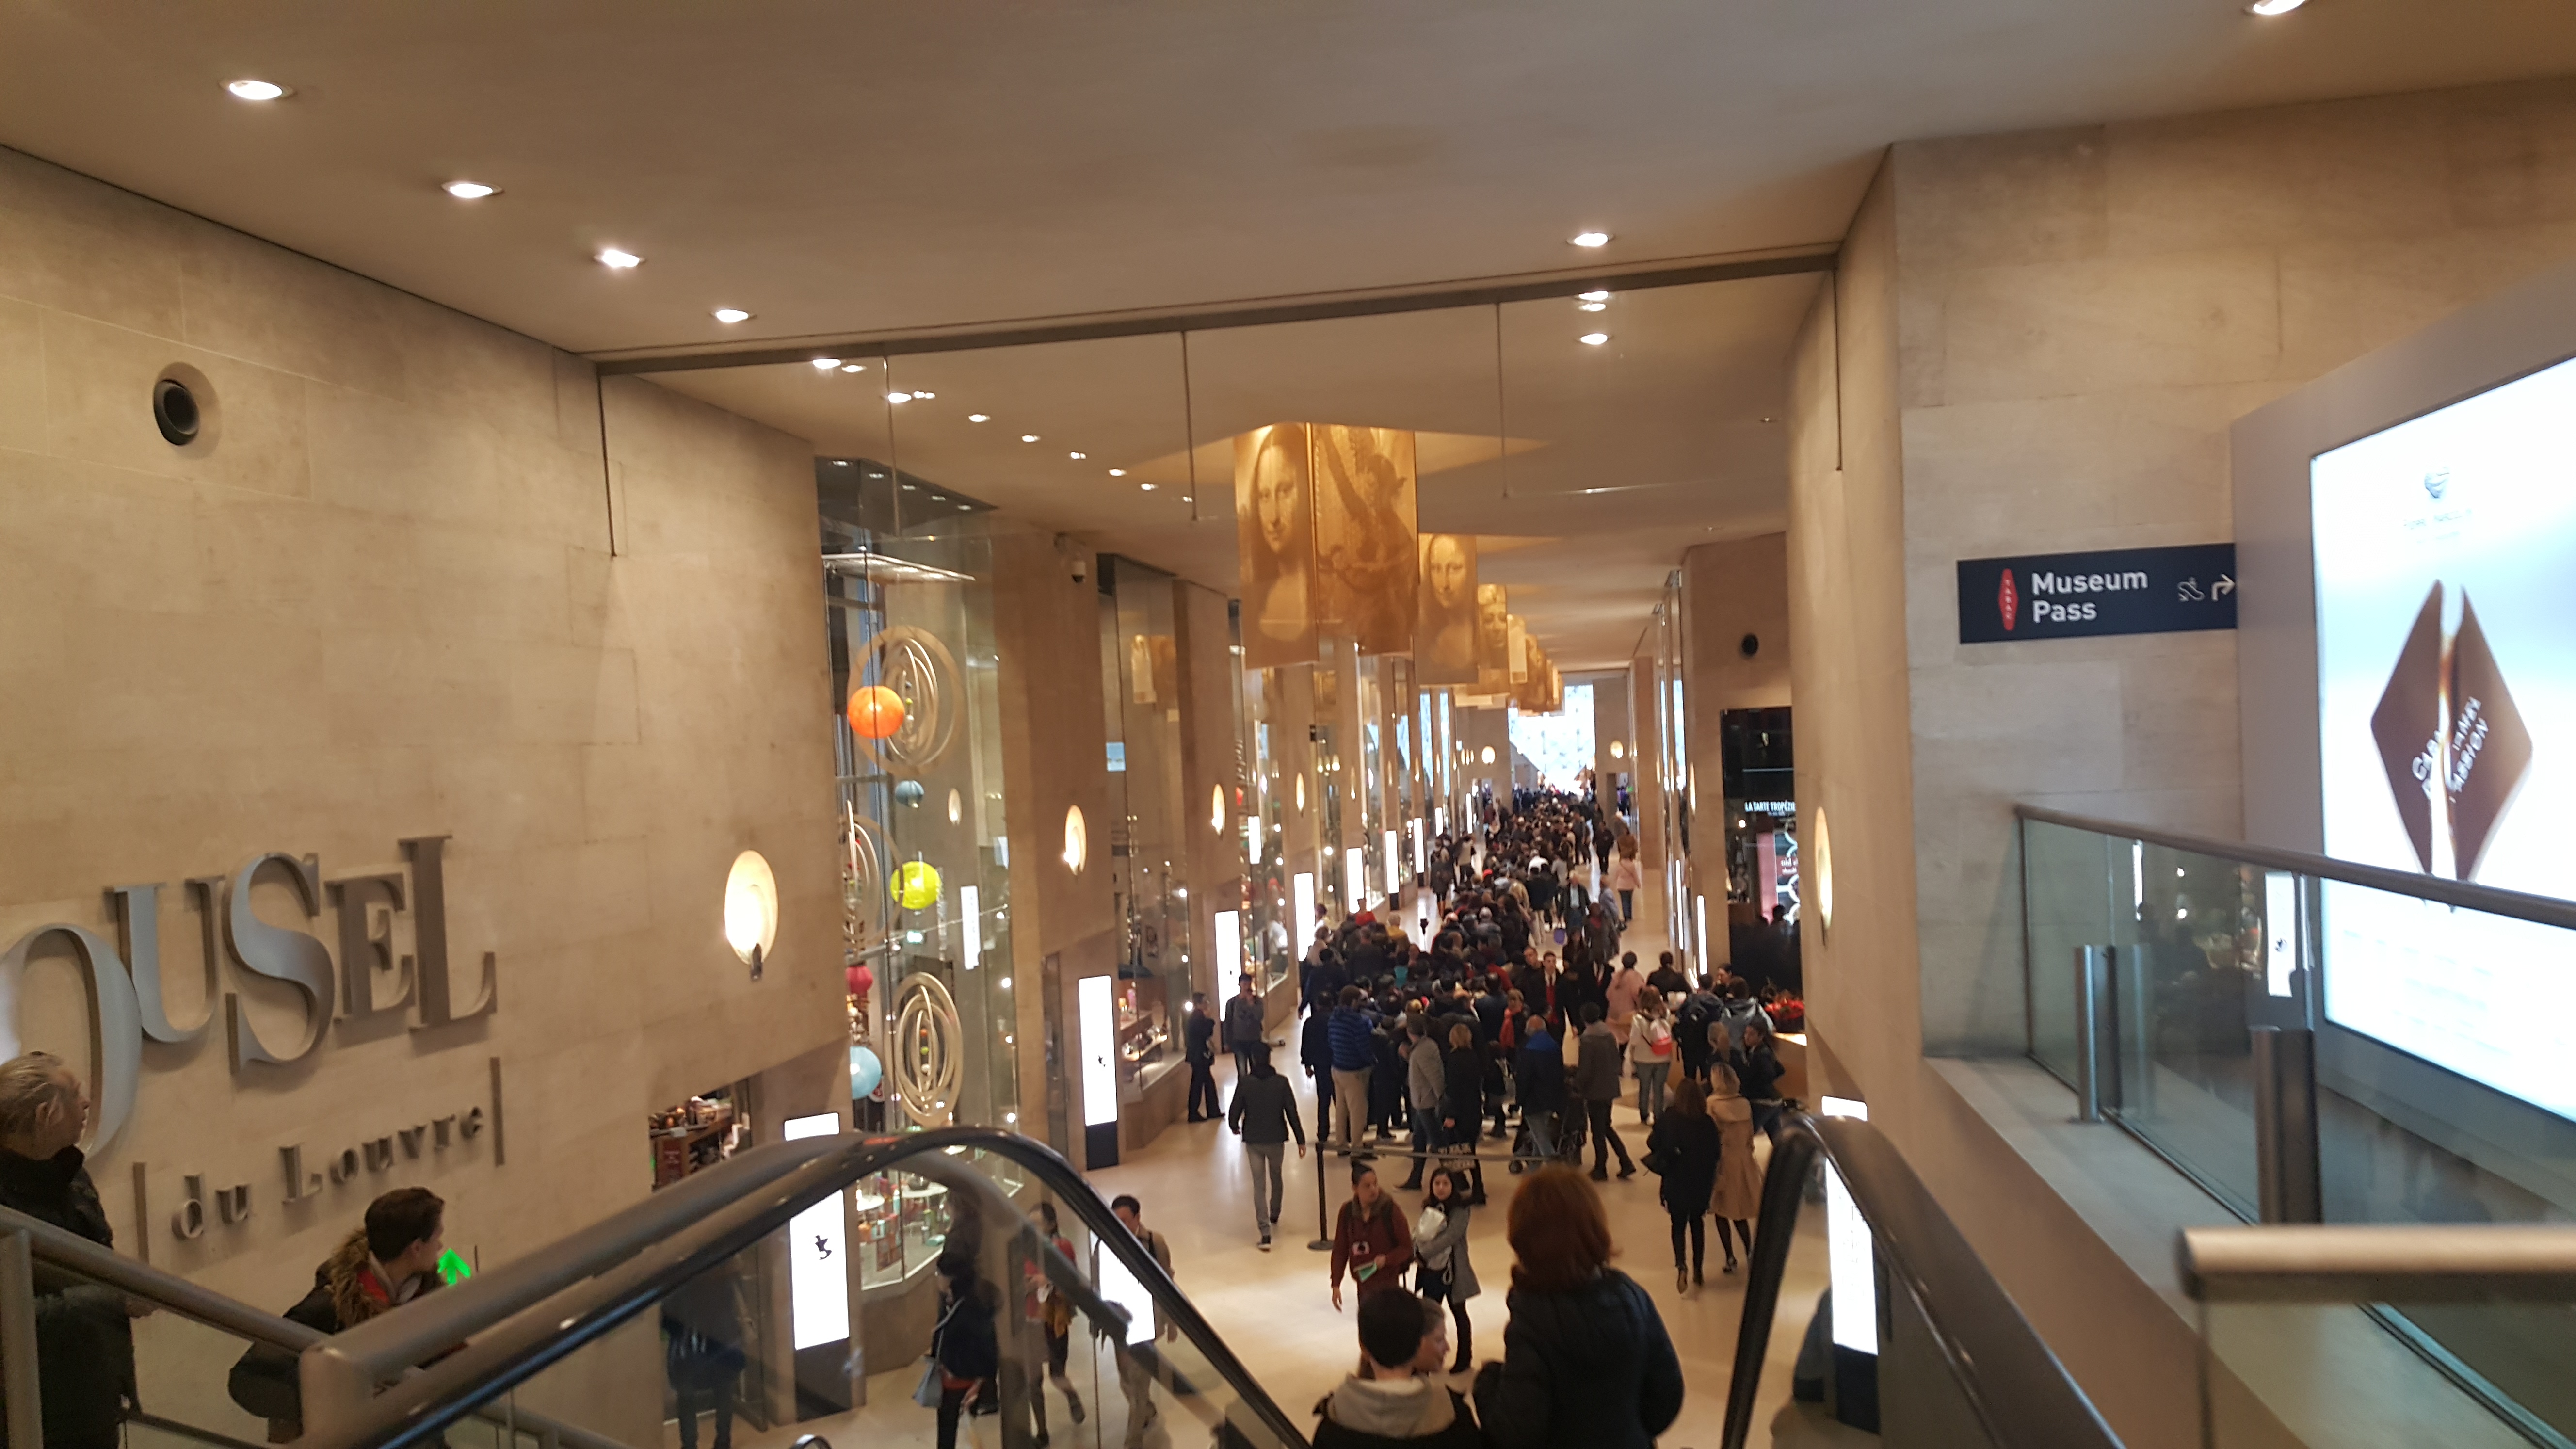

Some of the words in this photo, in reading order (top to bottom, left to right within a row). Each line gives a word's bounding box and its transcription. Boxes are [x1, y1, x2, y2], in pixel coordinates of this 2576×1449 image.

[2032, 571, 2148, 596] Museum
[2032, 599, 2097, 623] Pass
[1744, 801, 1753, 812] LA
[171, 1172, 254, 1240] du
[278, 1104, 485, 1205] Louvre
